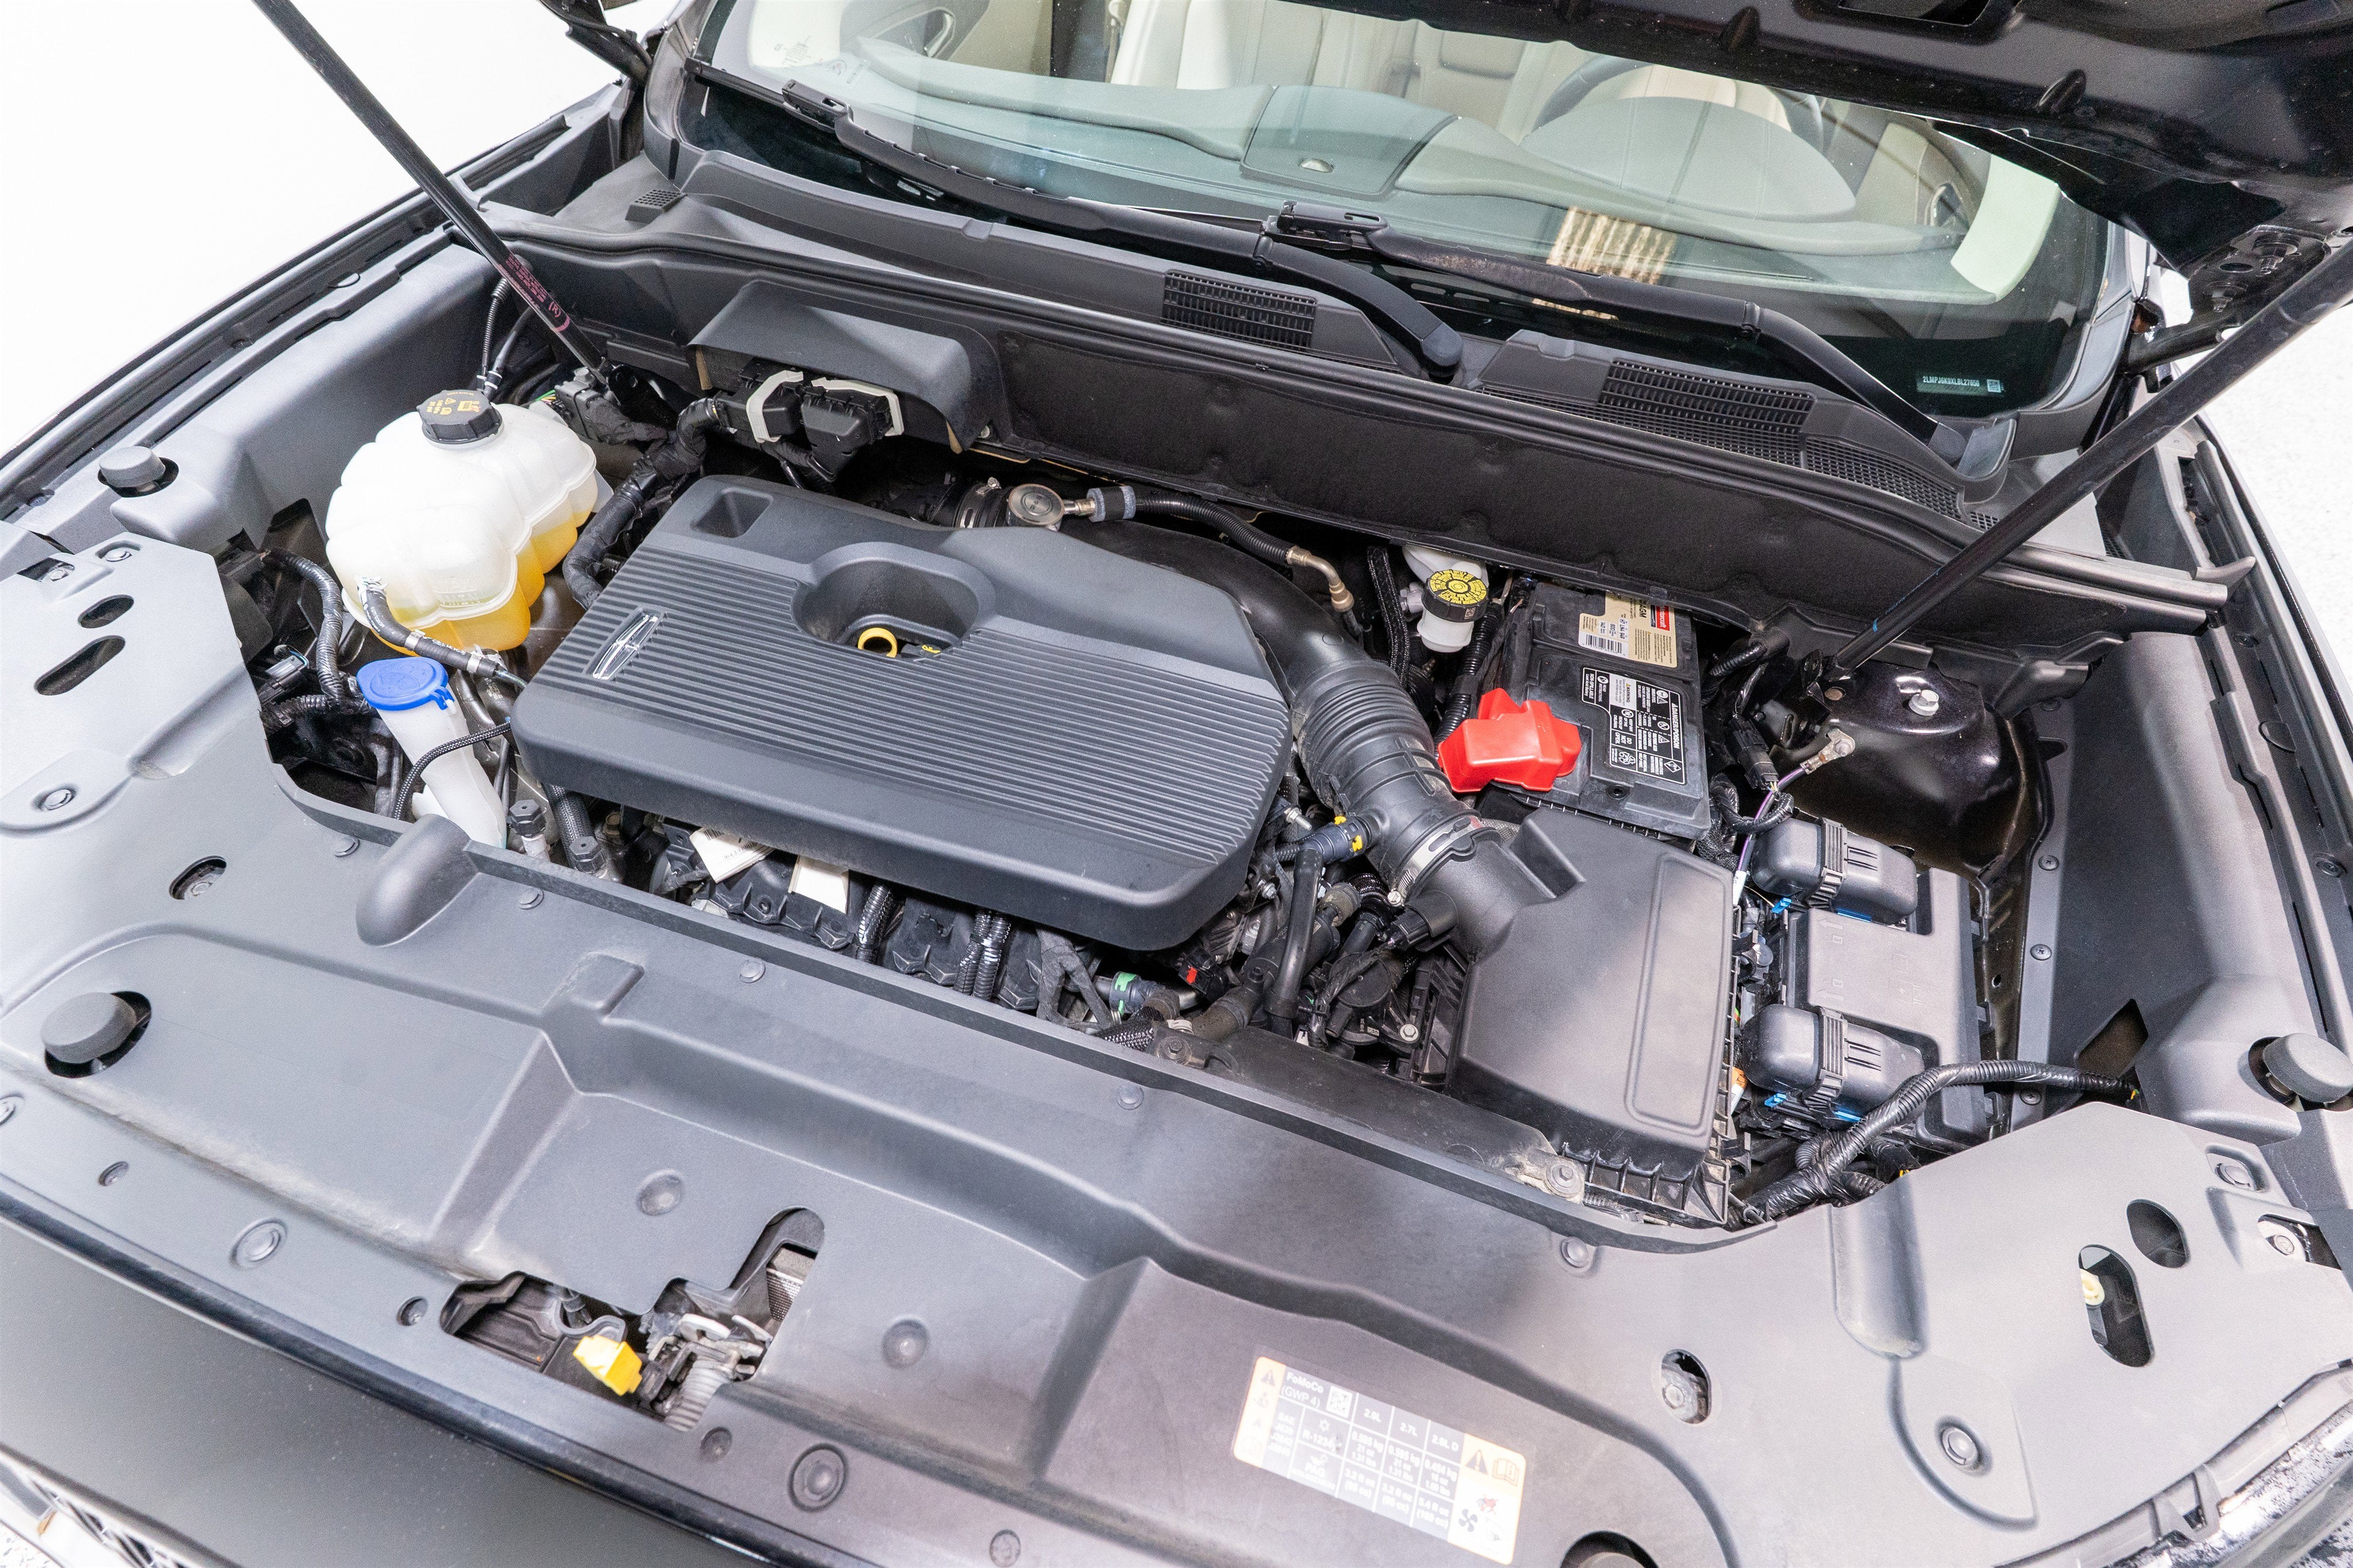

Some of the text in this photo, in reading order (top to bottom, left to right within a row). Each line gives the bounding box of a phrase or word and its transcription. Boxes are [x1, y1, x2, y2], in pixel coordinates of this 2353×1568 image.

[1638, 603, 1646, 618] AGM
[1672, 708, 1680, 748] DANGER/POISON
[1286, 1372, 1324, 1393] FoMoCo
[1281, 1385, 1320, 1409] (GWP 4)
[1278, 1412, 1295, 1425] SAE
[1363, 1408, 1381, 1423] 2.0L
[1399, 1422, 1418, 1436] 2.7L
[1373, 1439, 1384, 1453] kg
[1432, 1434, 1459, 1451] 2.0L D
[1365, 1449, 1375, 1457] oz
[1410, 1453, 1421, 1467] kg
[1305, 1462, 1325, 1478] PAG
[1402, 1463, 1411, 1472] oz
[1446, 1467, 1457, 1482] kg
[1344, 1468, 1357, 1481] 3.2
[1364, 1477, 1376, 1488] oz
[1439, 1477, 1448, 1486] oz
[1382, 1482, 1395, 1494] 3.2
[1402, 1492, 1413, 1502] oz
[1438, 1507, 1449, 1517] oz
